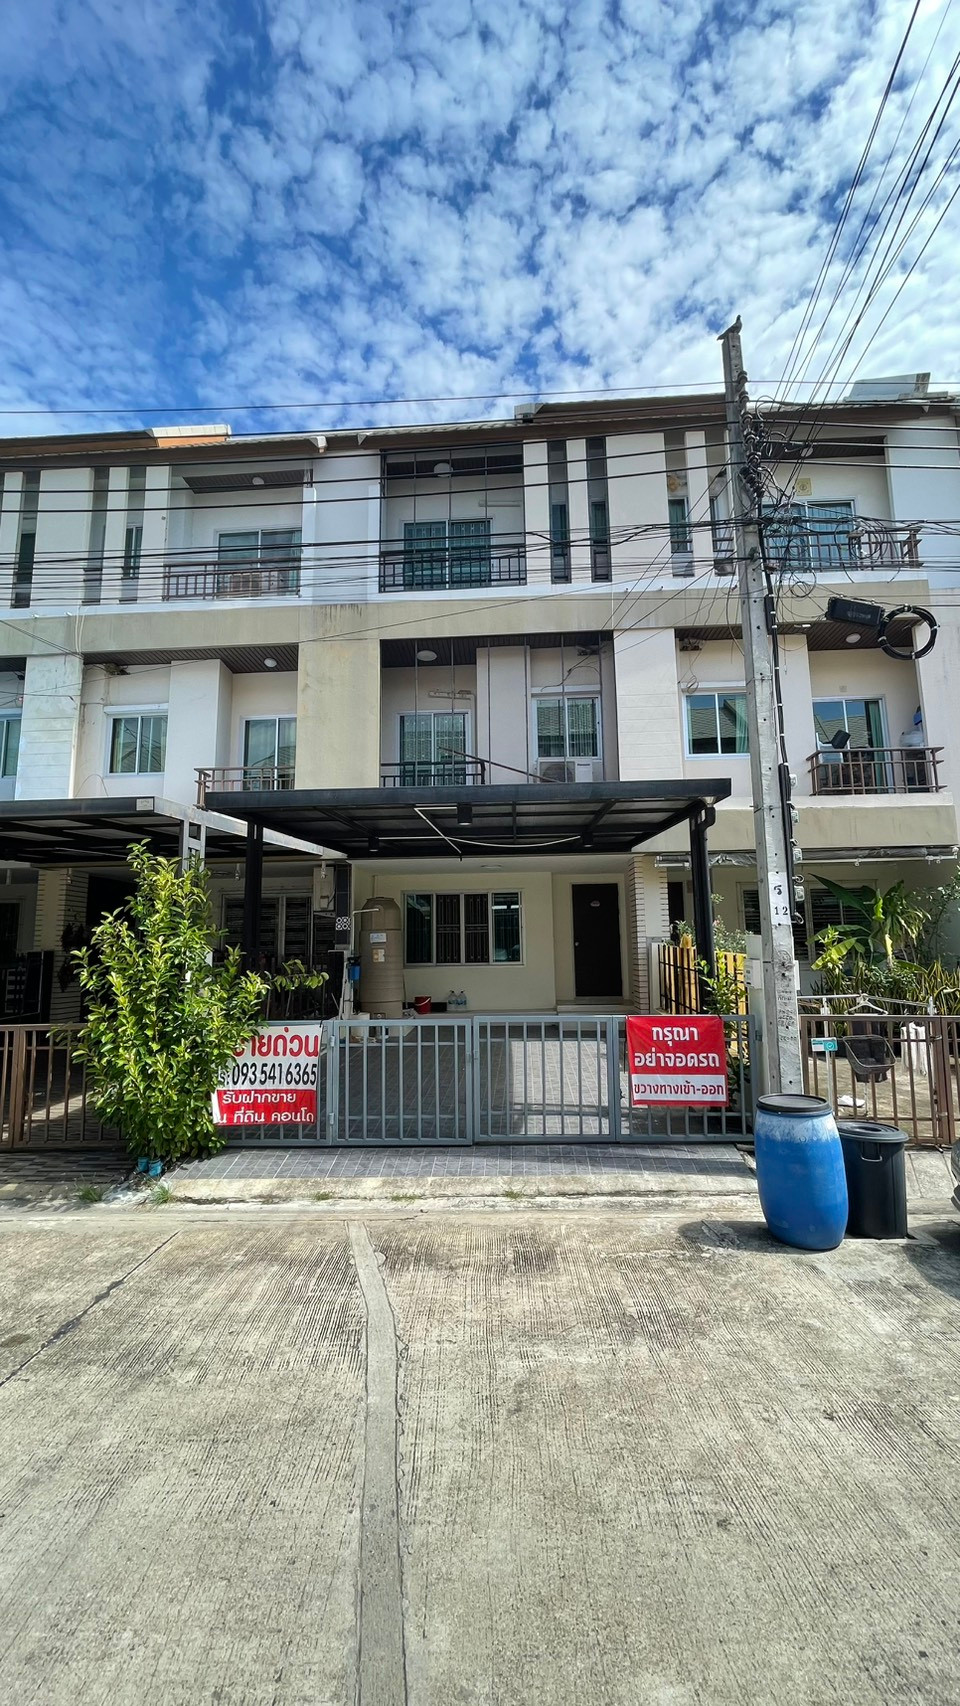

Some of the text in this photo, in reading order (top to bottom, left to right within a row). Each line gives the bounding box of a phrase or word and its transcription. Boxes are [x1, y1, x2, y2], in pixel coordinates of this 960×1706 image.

[652, 1027, 699, 1046] กรุณา
[634, 1047, 719, 1067] อย่าจอดรถ
[634, 1080, 724, 1095] ขวางทางเข้า-ออก
[223, 1091, 296, 1104] รับฝากขาย
[234, 1106, 265, 1123] ที่ดิน
